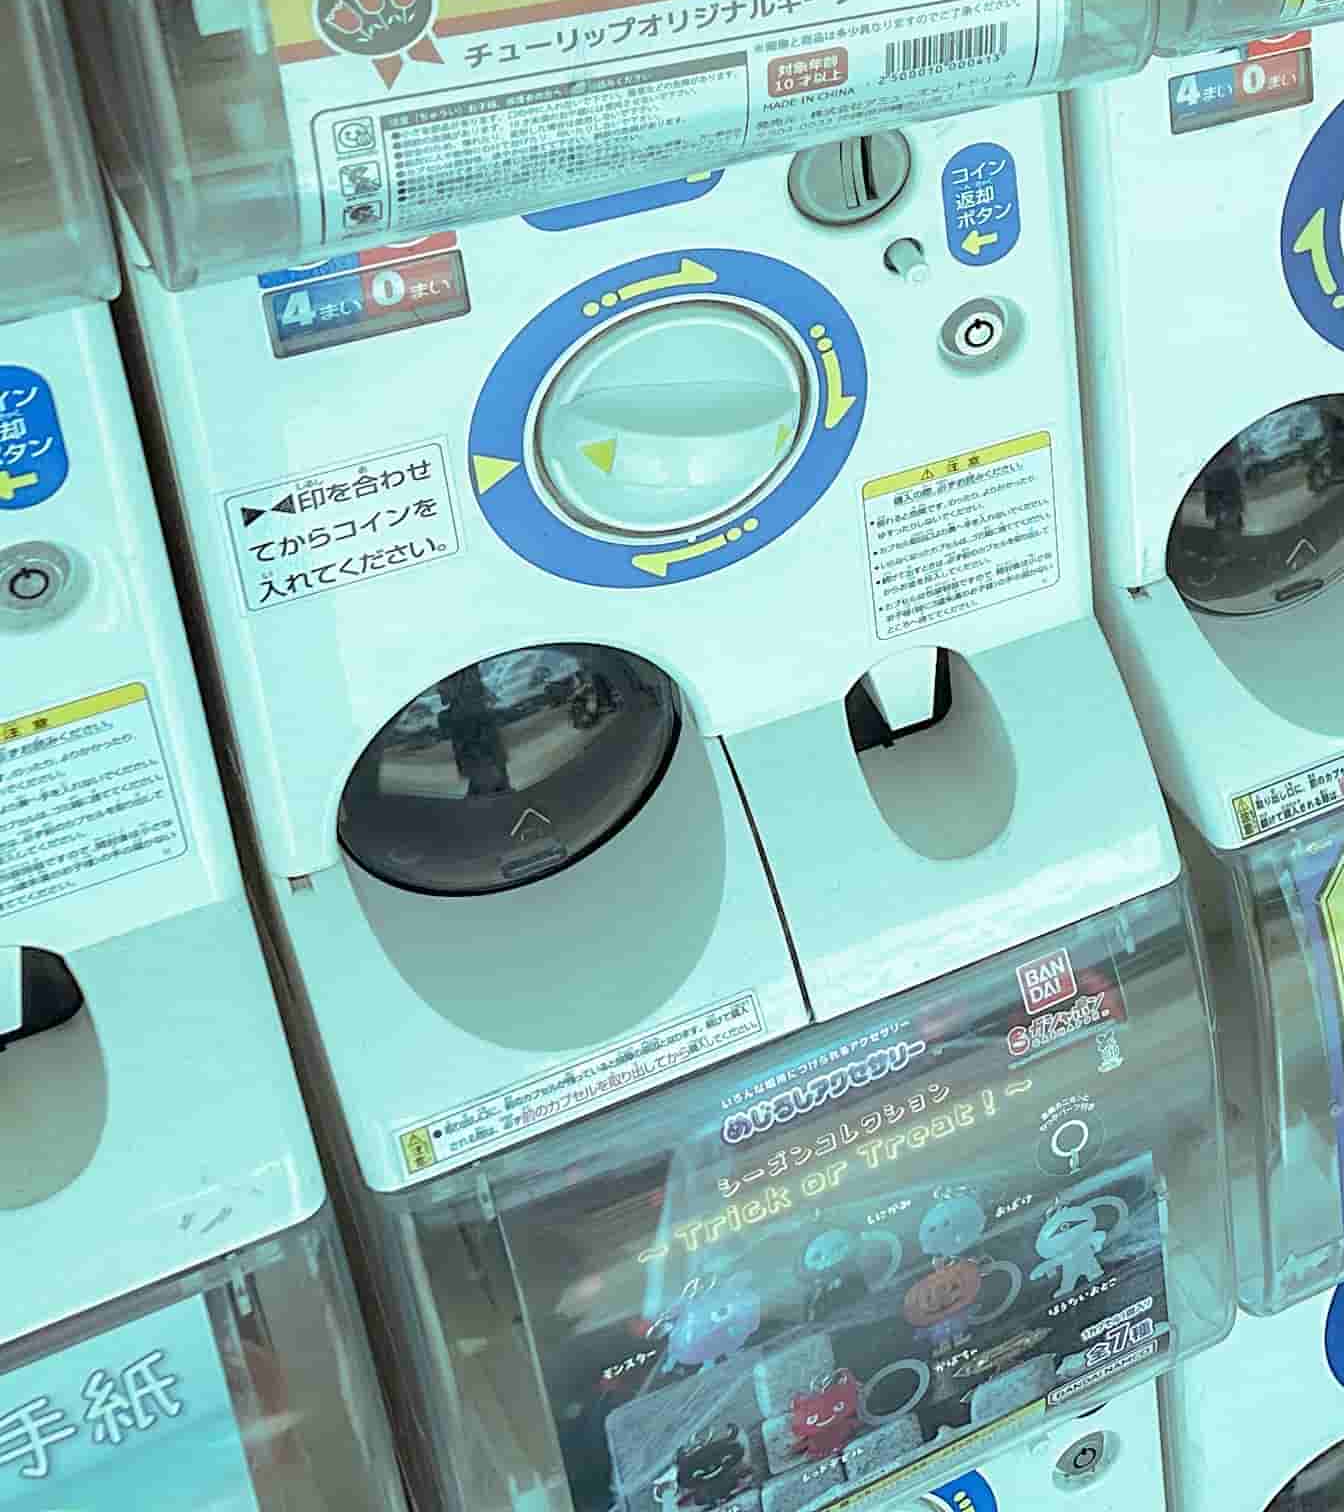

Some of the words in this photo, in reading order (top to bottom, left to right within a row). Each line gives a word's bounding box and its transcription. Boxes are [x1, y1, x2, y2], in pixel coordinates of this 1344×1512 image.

[950, 158, 1008, 185] コイン
[955, 185, 996, 212] 返却
[956, 201, 1014, 229] ボタン
[279, 288, 363, 329] 4まい
[370, 269, 451, 307] 0まい
[299, 458, 432, 513] 印を合わせ
[249, 497, 438, 563] てからコインを
[260, 536, 447, 604] 入れてください。
[1024, 956, 1066, 989] BAN
[1029, 979, 1062, 1004] DAI
[721, 1039, 927, 1144] めじるしアクセサリー
[717, 1081, 950, 1198] シーズンコレクション
[674, 1185, 793, 1253] Trick
[802, 1158, 850, 1196] or
[602, 1348, 657, 1381] モンスター
[0, 1349, 183, 1479] 手紙
